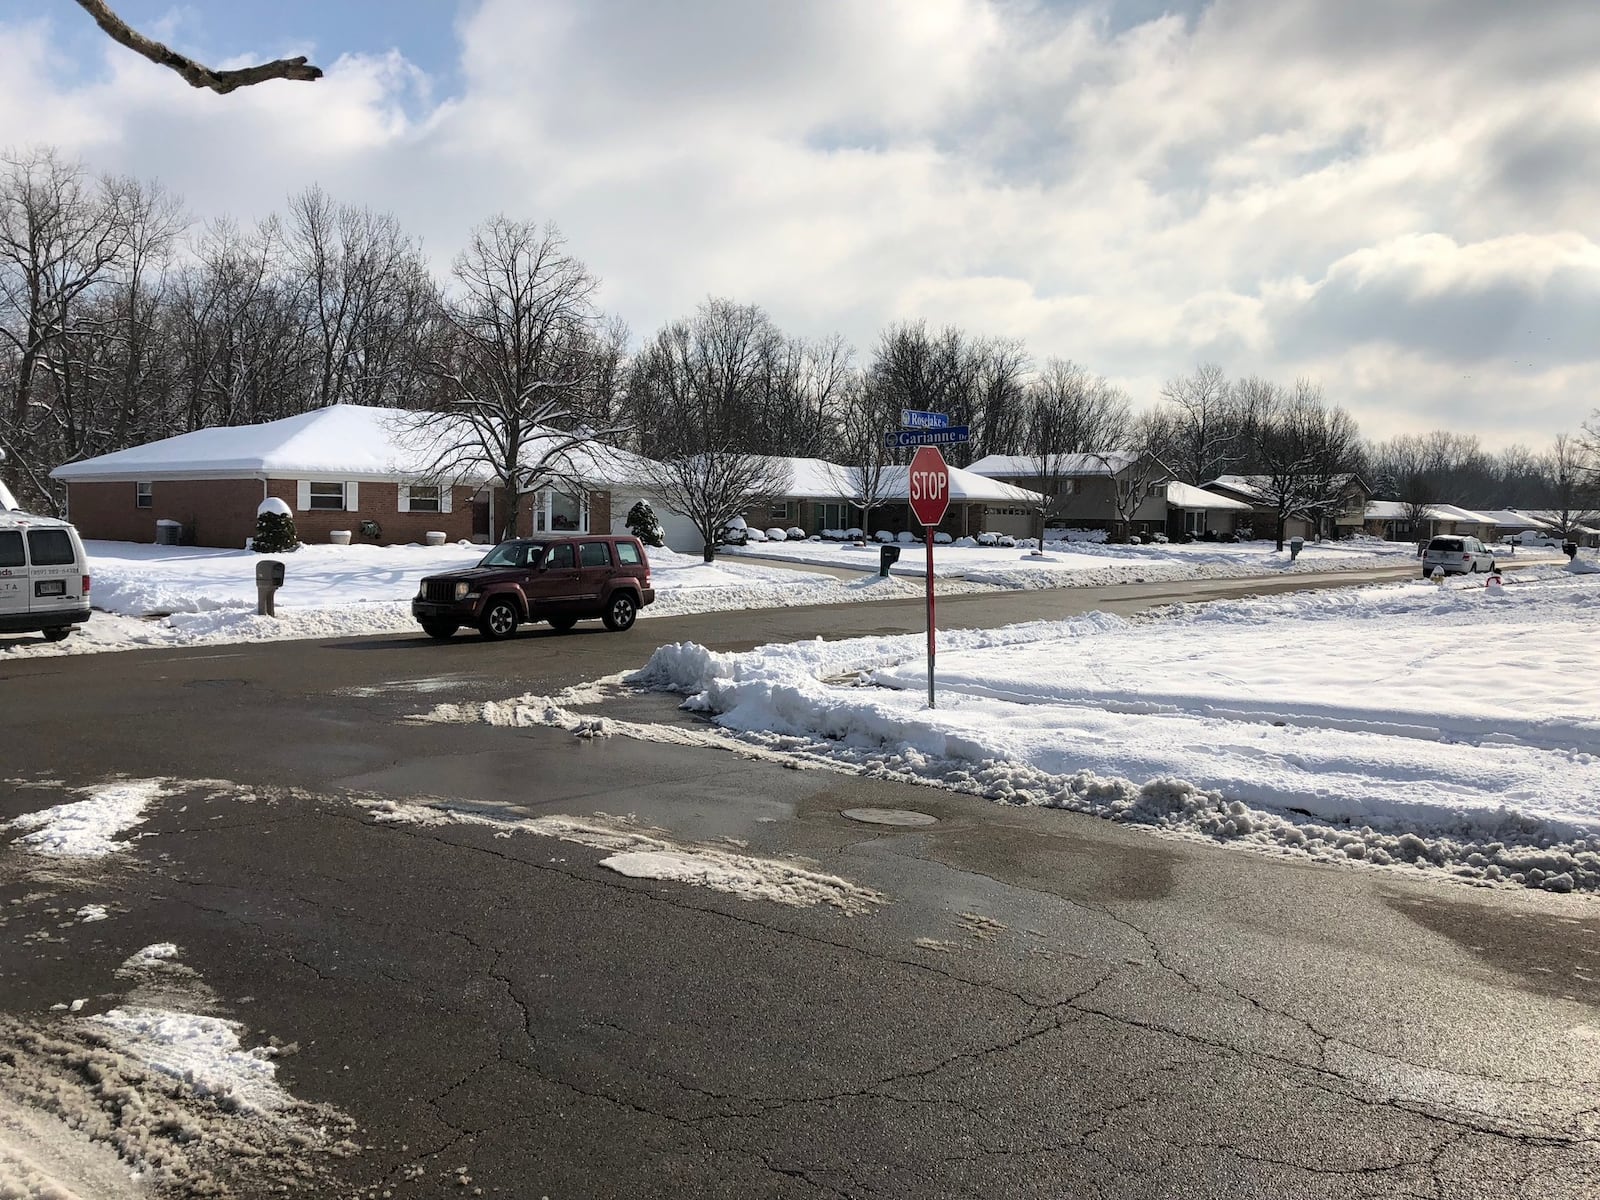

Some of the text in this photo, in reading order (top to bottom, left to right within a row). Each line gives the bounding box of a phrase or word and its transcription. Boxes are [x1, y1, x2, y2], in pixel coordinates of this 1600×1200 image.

[911, 412, 942, 427] Roselake
[899, 431, 968, 445] Garianne Dr
[912, 471, 947, 500] STOP
